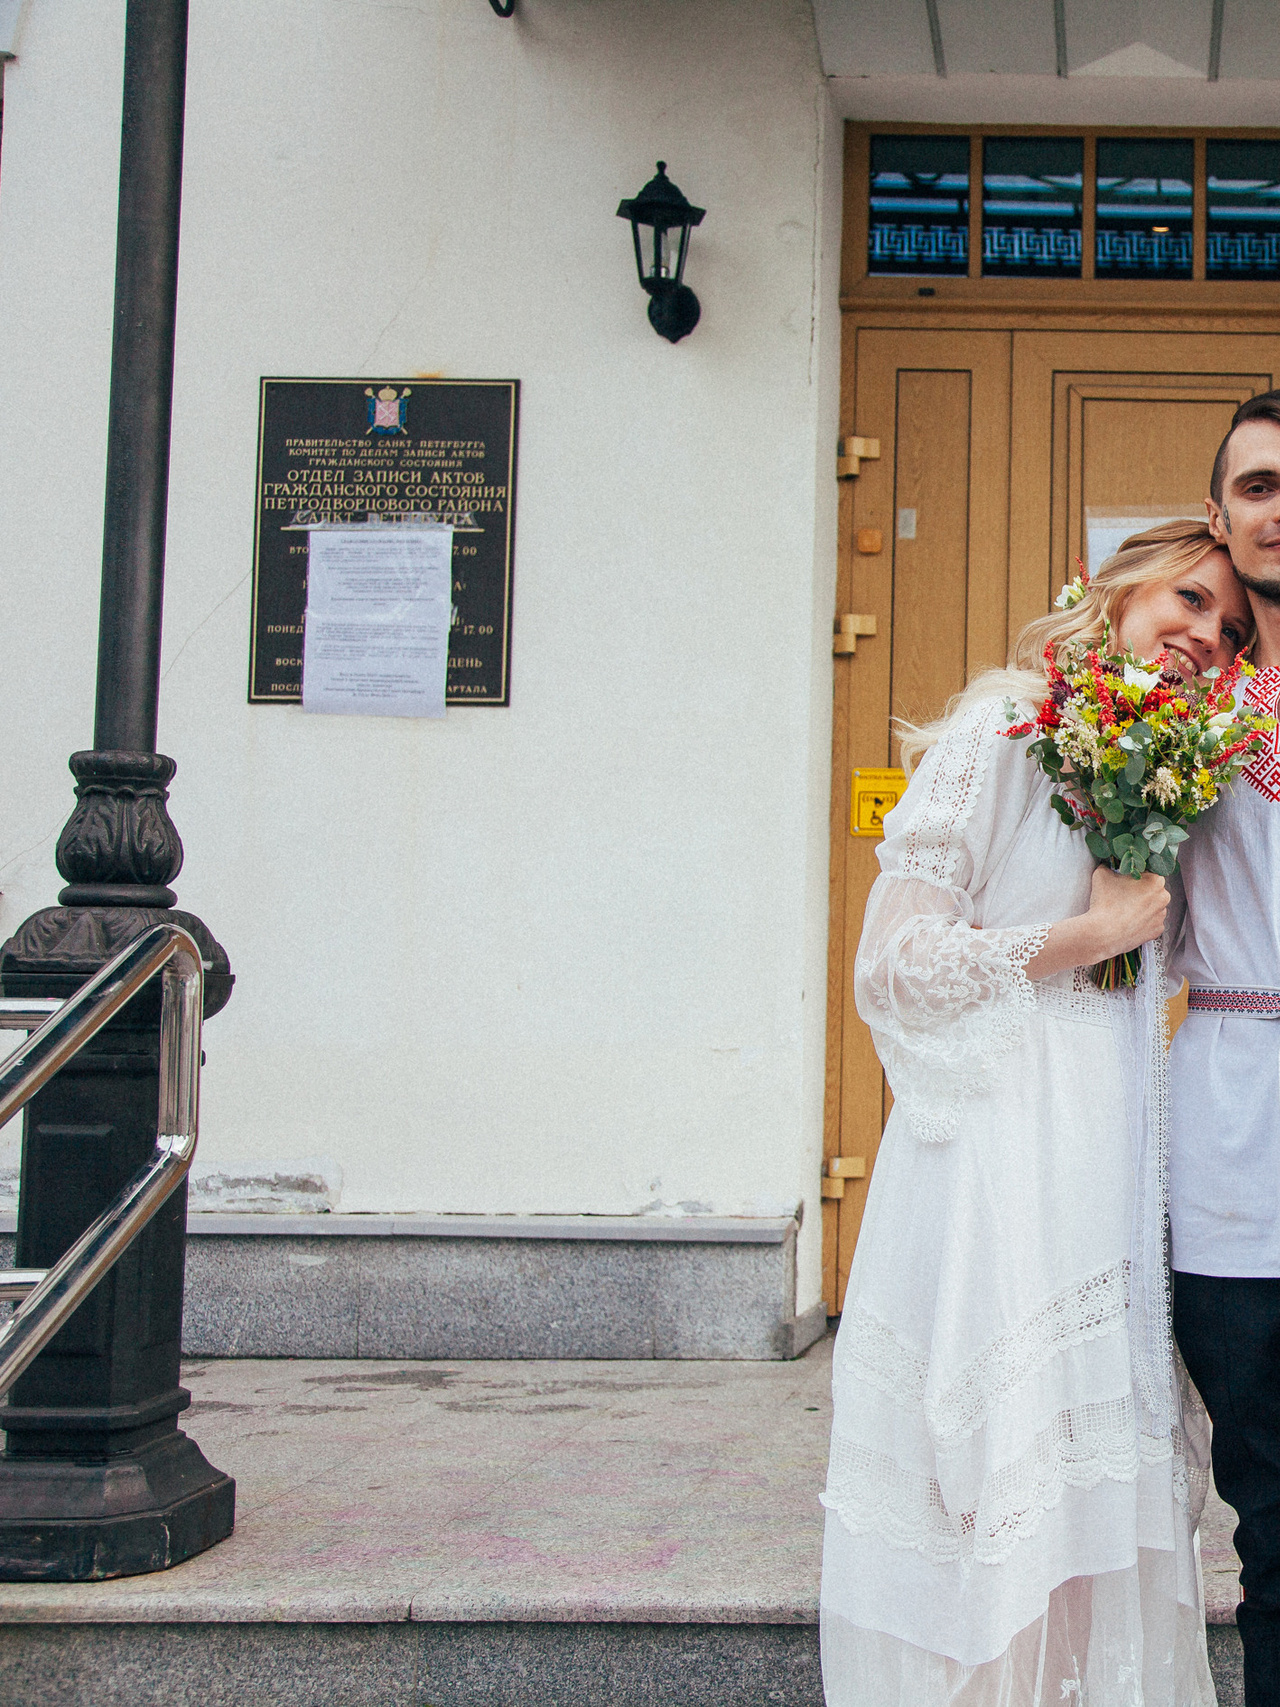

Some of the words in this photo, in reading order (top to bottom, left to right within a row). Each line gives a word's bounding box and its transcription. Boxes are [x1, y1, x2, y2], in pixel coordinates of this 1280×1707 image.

[286, 439, 372, 448] ПРАВИТЕЛЬСТВО
[378, 440, 411, 448] САНКТ
[420, 440, 486, 449] ПЕТЕРБУРГА
[289, 448, 336, 456] КОМИТЕТ
[342, 449, 356, 457] ПО
[360, 449, 398, 457] ДЕЛАМ
[403, 449, 445, 458] ЗАПИСИ
[451, 450, 485, 458] АКТОВ
[309, 458, 394, 467] ГРАЖДАНСКОГО
[400, 459, 463, 468] СОСТОЯНИЯ
[287, 470, 346, 483] ОТДЕЛ
[353, 470, 421, 483] ЗАПИСИ
[431, 471, 485, 484] АКТОВ
[264, 483, 397, 497] ГРАЖДАНСКОГО
[406, 485, 506, 498] СОСТОЯНИЯ
[264, 498, 432, 512] ПЕТРОДВОРЦОВОГО
[438, 498, 504, 513] РАЙОНА
[447, 686, 487, 694] АРТАЛА
